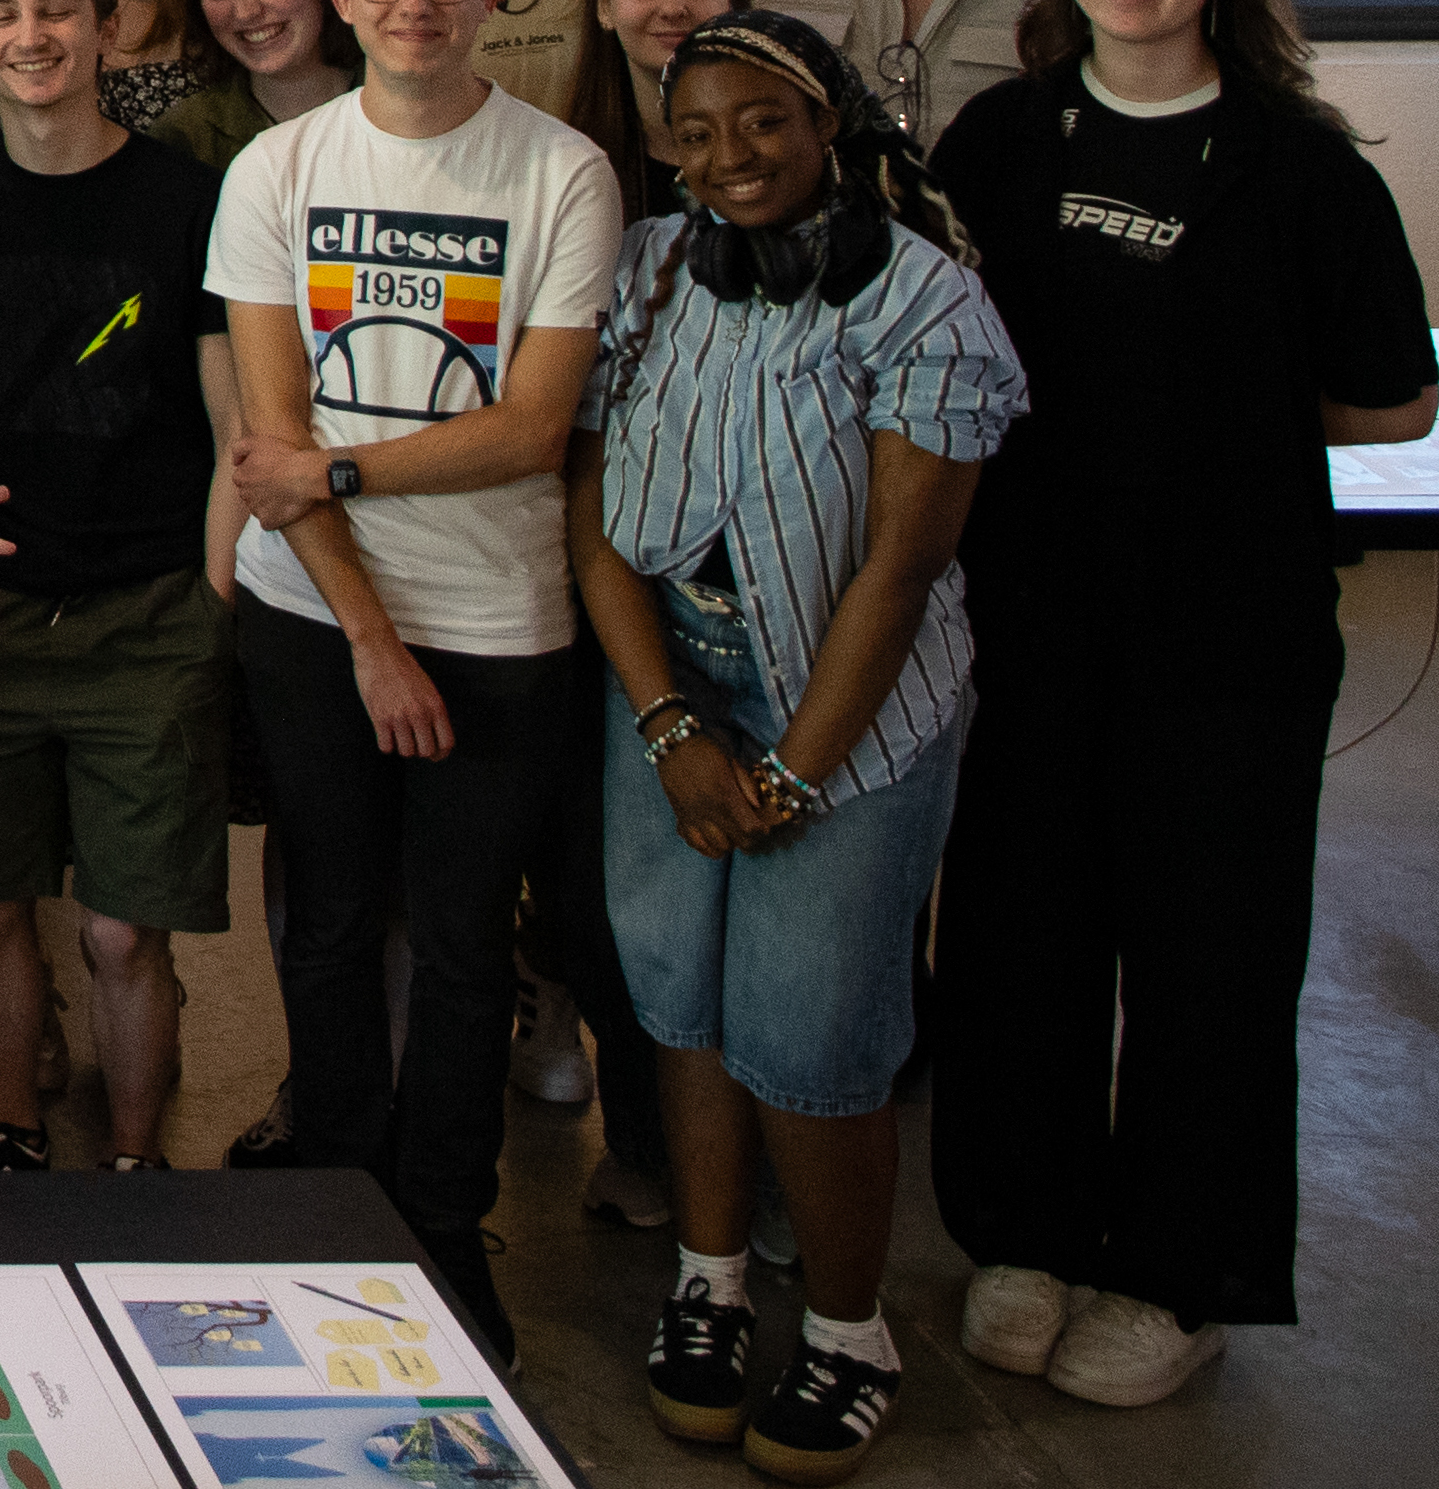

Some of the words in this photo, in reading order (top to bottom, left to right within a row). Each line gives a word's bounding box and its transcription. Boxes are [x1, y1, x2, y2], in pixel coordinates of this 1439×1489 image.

[481, 37, 512, 53] Jack
[514, 36, 524, 47] &
[526, 33, 564, 47] Jones
[311, 212, 500, 265] ellesse
[1059, 200, 1185, 247] SPEED
[355, 269, 443, 311] 1959
